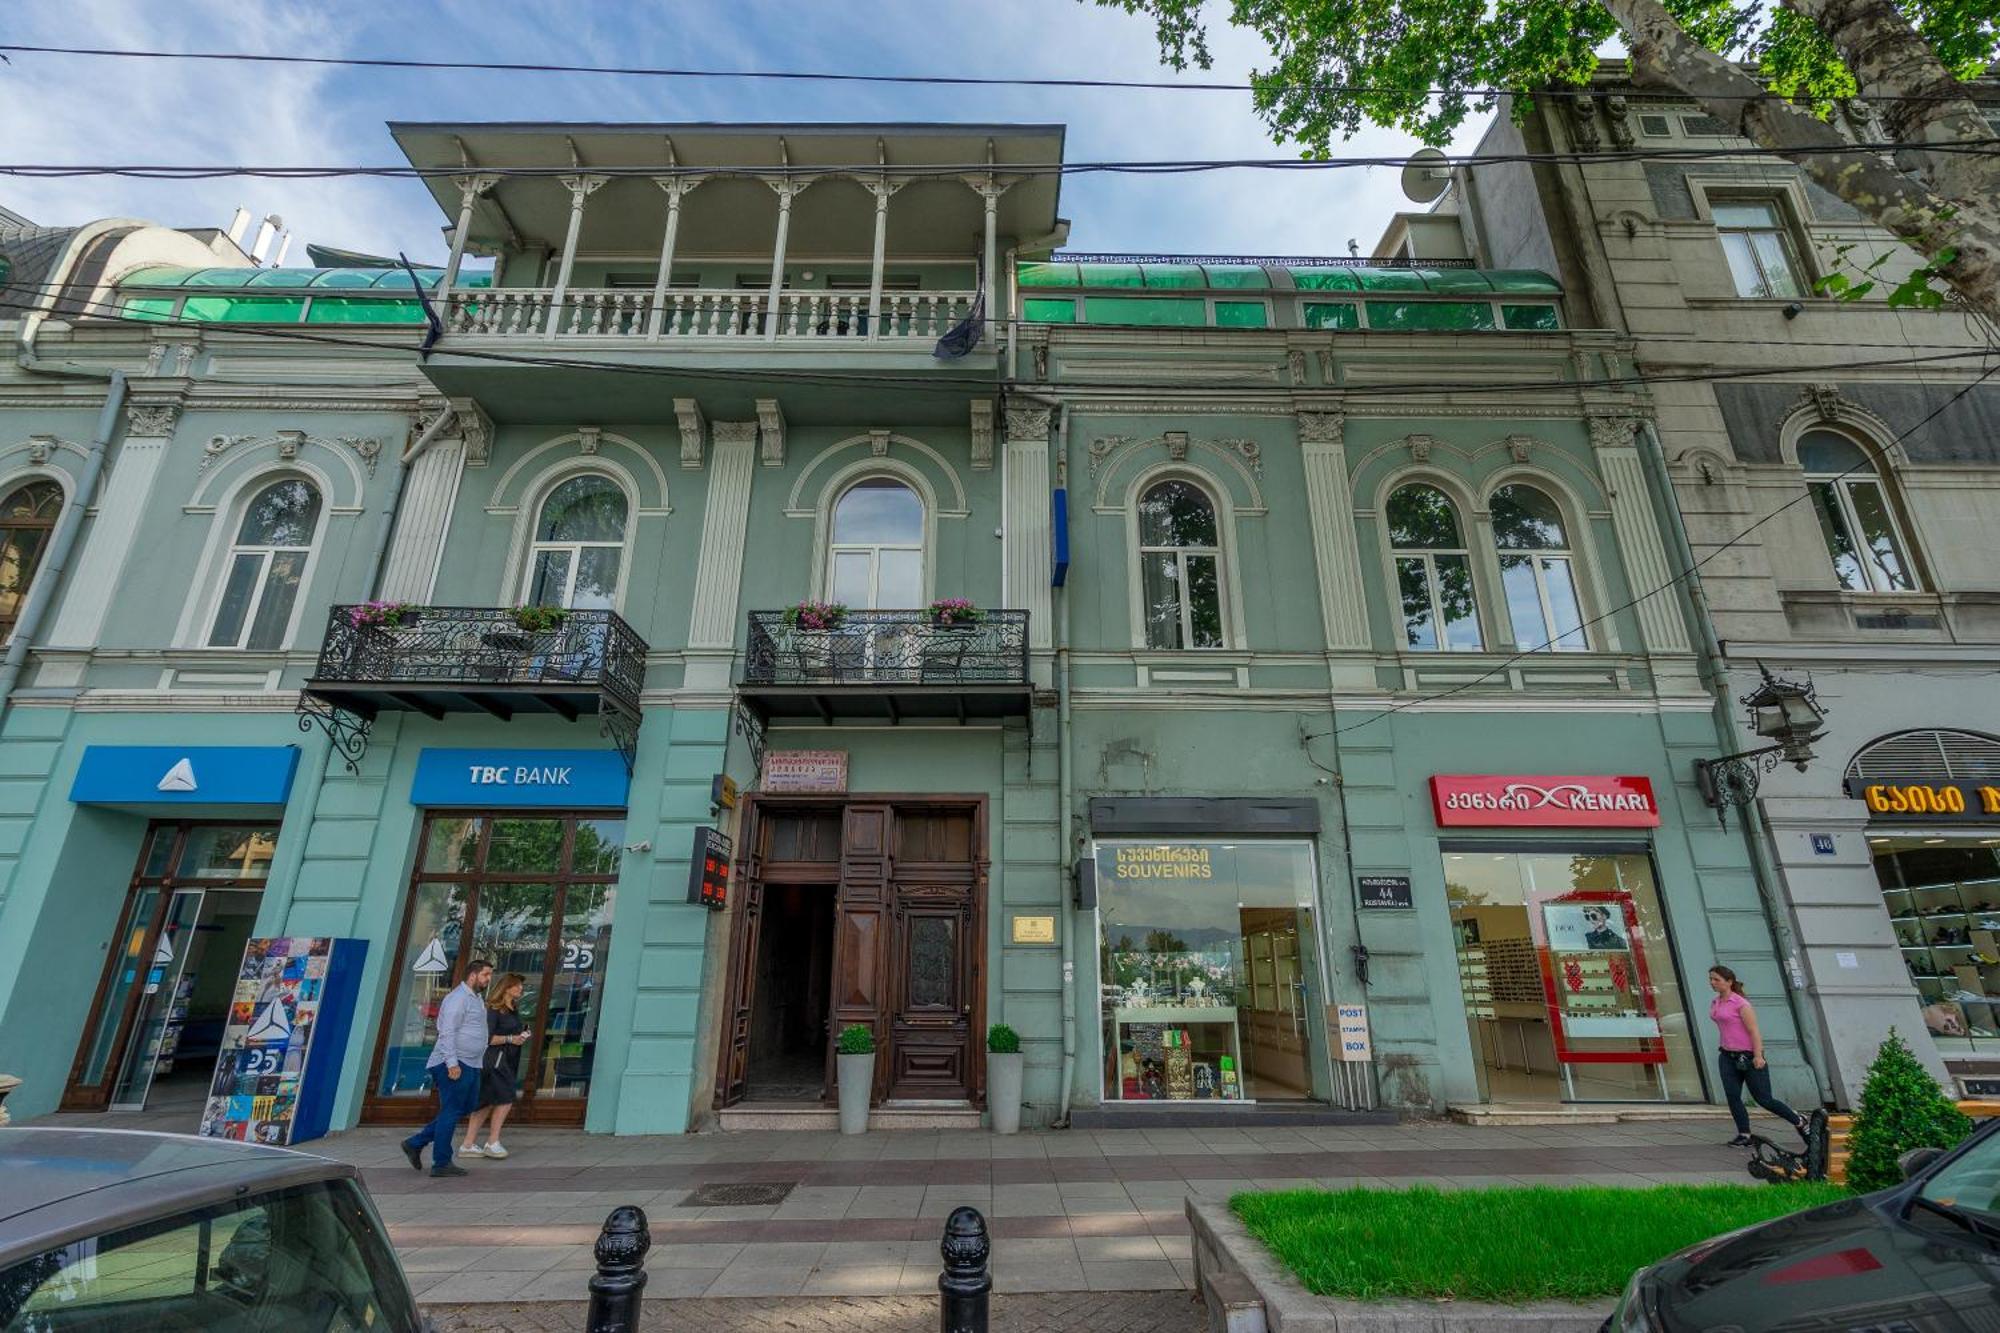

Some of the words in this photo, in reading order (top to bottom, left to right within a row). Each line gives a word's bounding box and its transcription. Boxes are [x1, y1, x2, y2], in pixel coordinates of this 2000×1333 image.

[469, 766, 509, 784] TBC
[514, 767, 571, 785] BANK
[1447, 793, 1530, 810] კენარი
[1569, 792, 1649, 811] KENARI
[1816, 838, 1833, 850] 46
[1117, 863, 1212, 878] SOUVENIRS
[563, 944, 595, 968] 25
[1339, 1008, 1363, 1017] POST
[1345, 1042, 1366, 1051] BOX
[246, 1049, 279, 1075] 25
